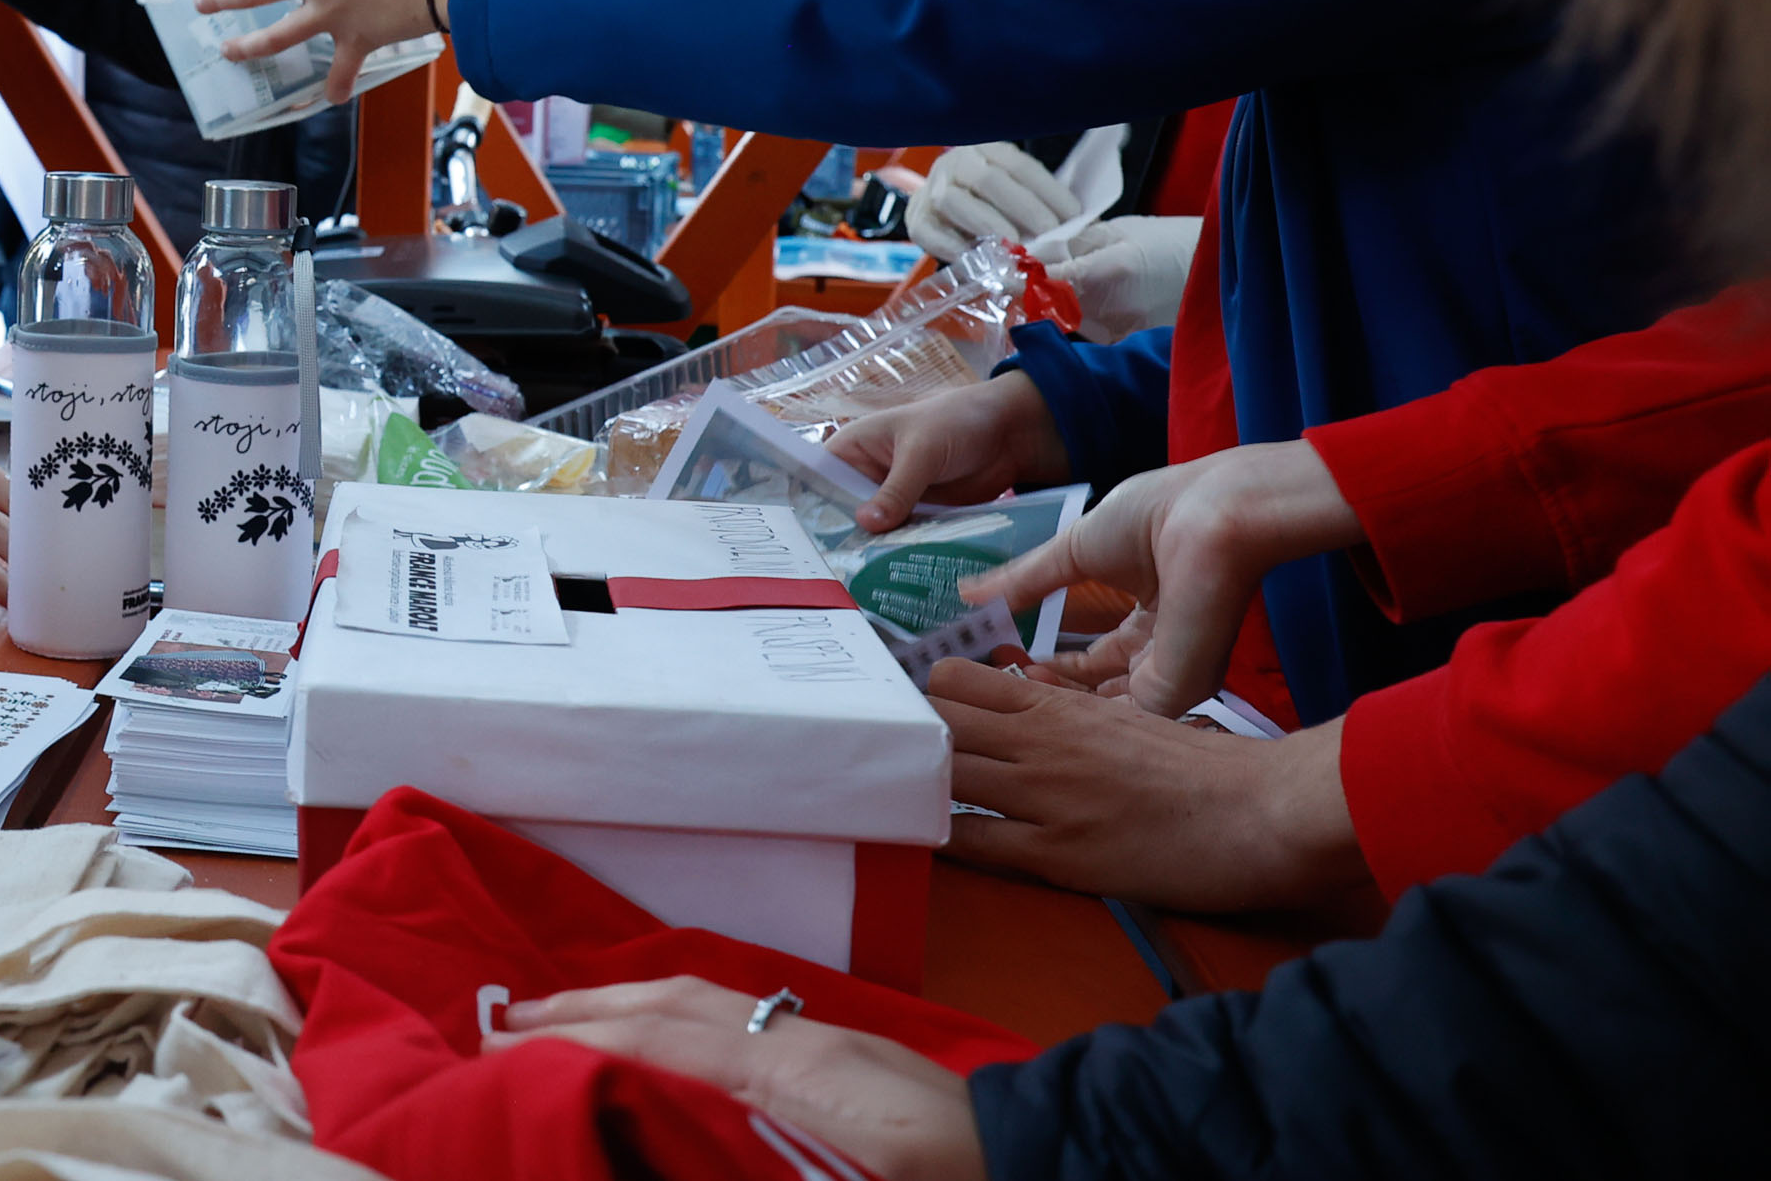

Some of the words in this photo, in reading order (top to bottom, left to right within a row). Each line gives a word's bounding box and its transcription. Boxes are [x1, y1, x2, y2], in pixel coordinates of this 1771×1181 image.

[109, 382, 153, 417] stoj
[408, 550, 438, 590] FRANCE
[408, 589, 439, 633] MAROLT
